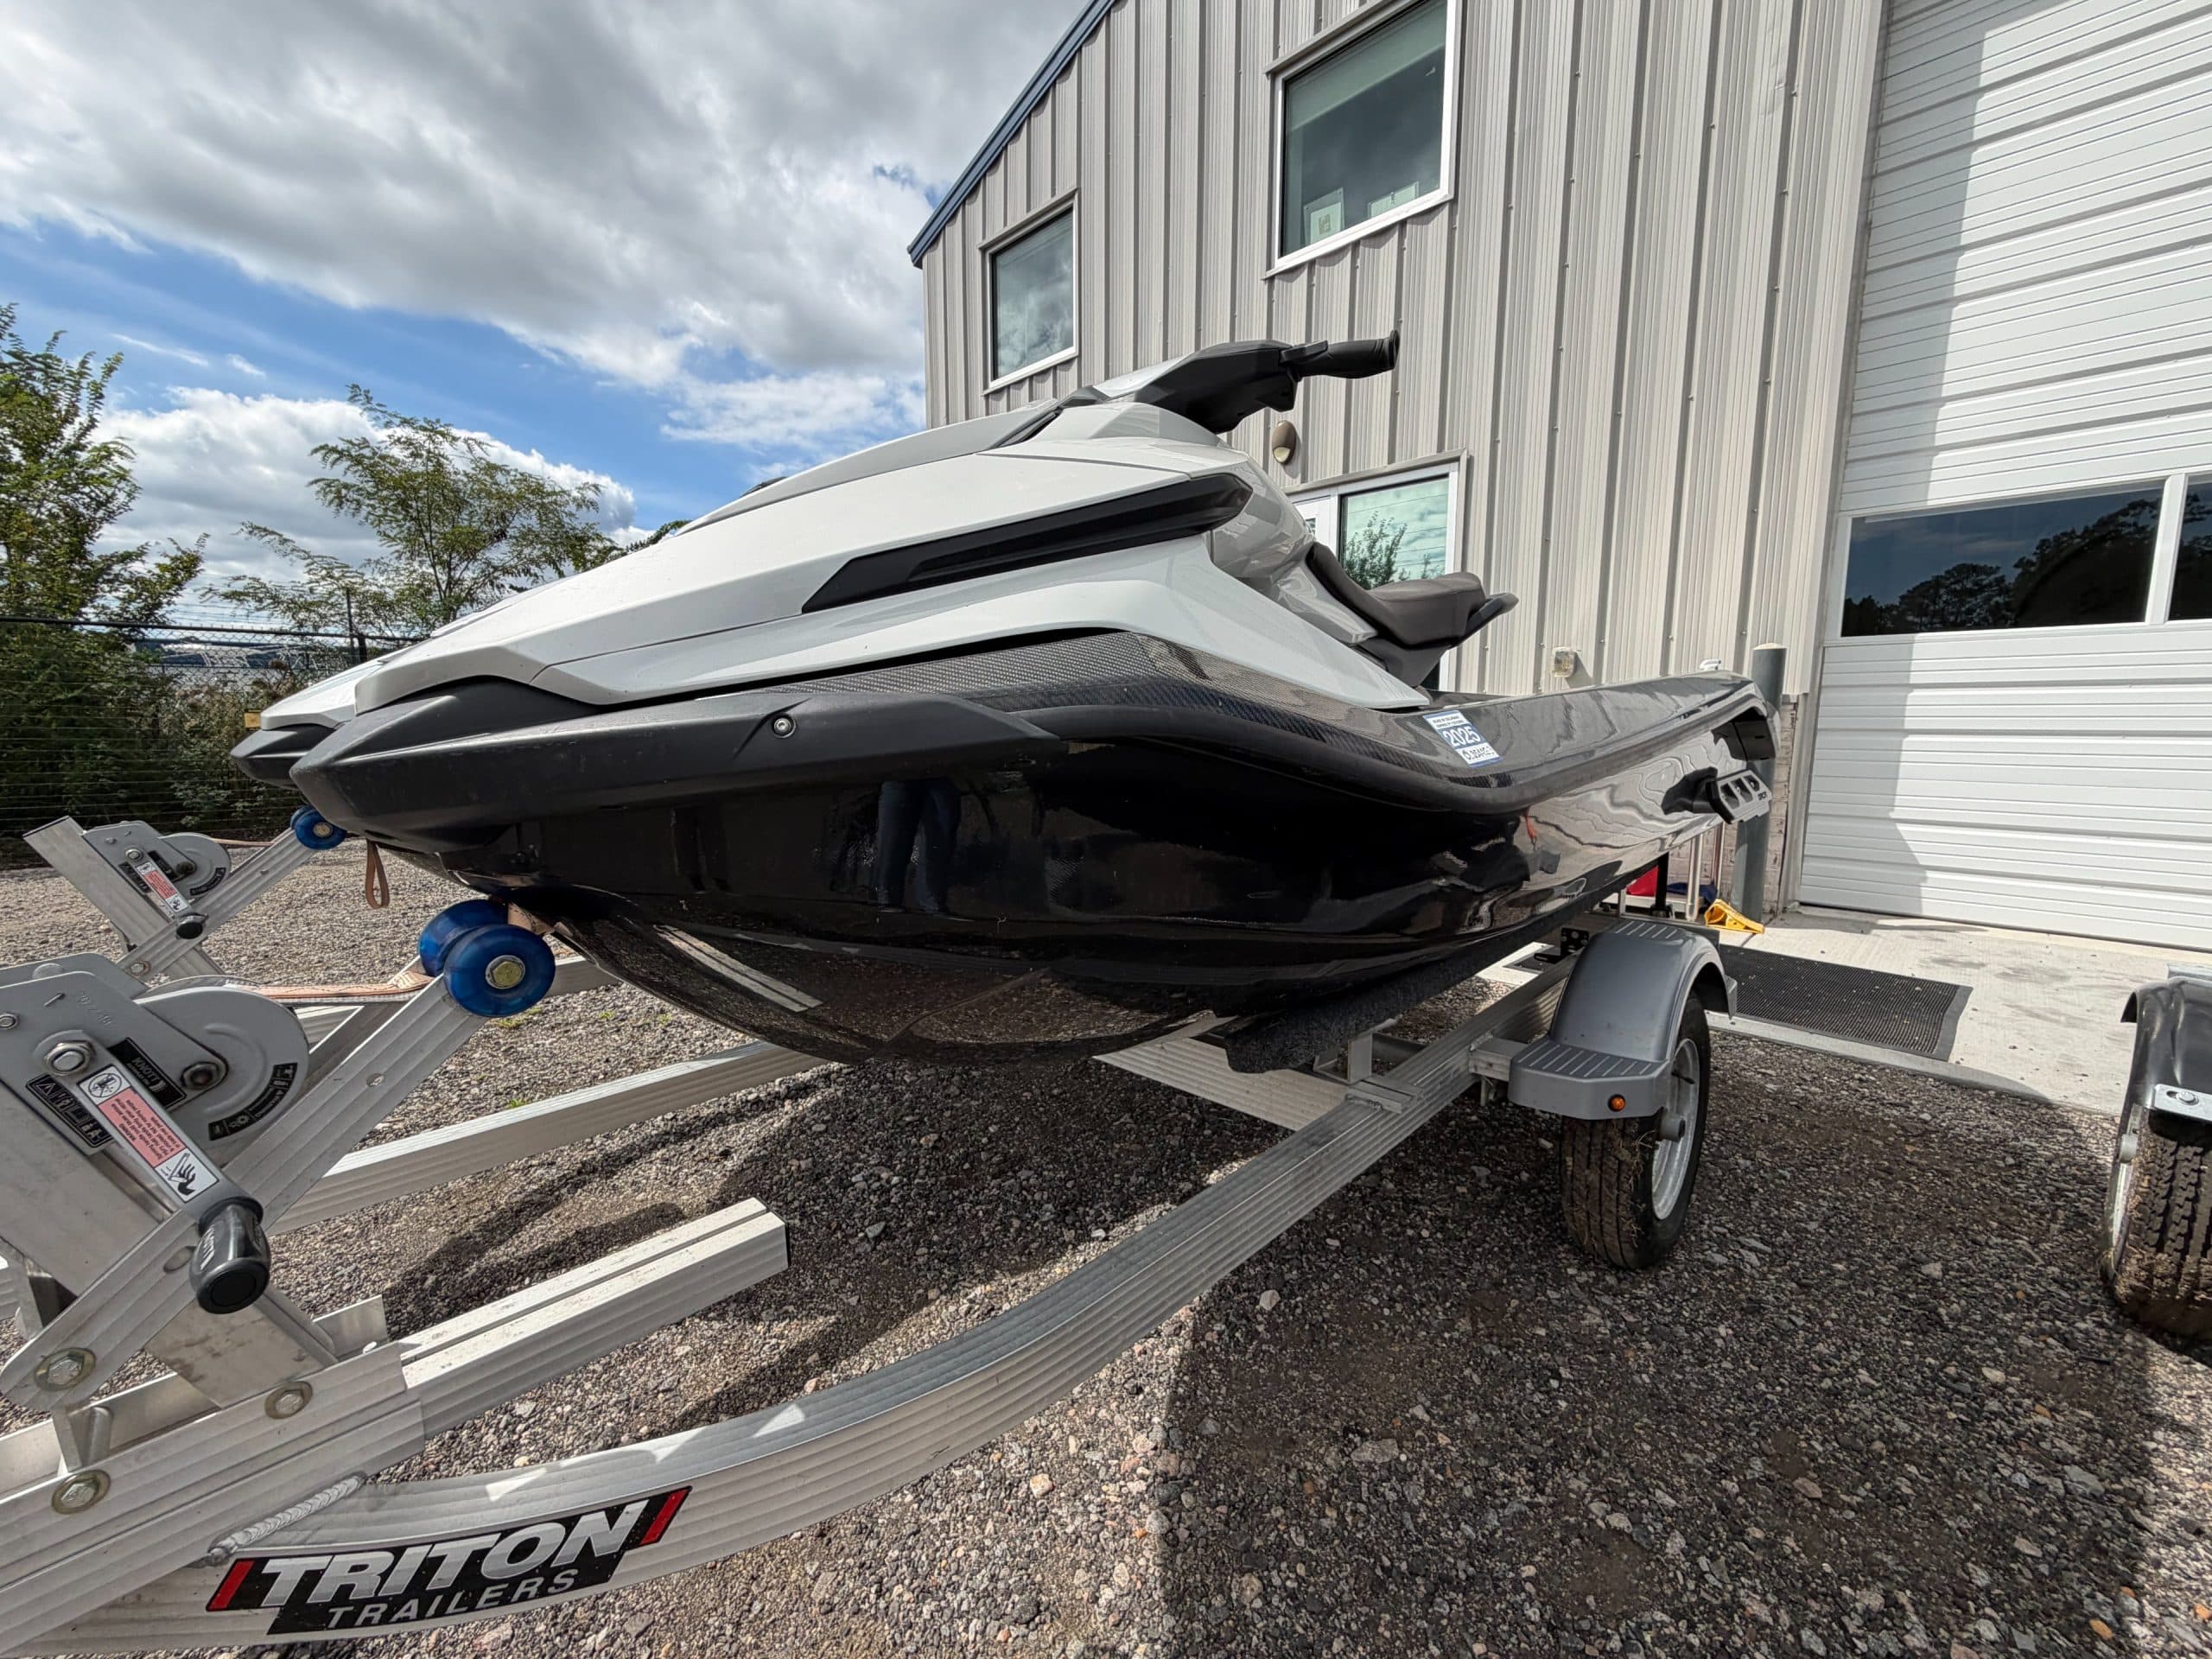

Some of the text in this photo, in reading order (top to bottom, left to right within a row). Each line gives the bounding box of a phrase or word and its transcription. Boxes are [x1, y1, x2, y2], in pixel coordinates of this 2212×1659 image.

[1442, 727, 1480, 747] 2025
[261, 1499, 648, 1607] TRITON
[328, 1568, 579, 1630] TRAILERS
